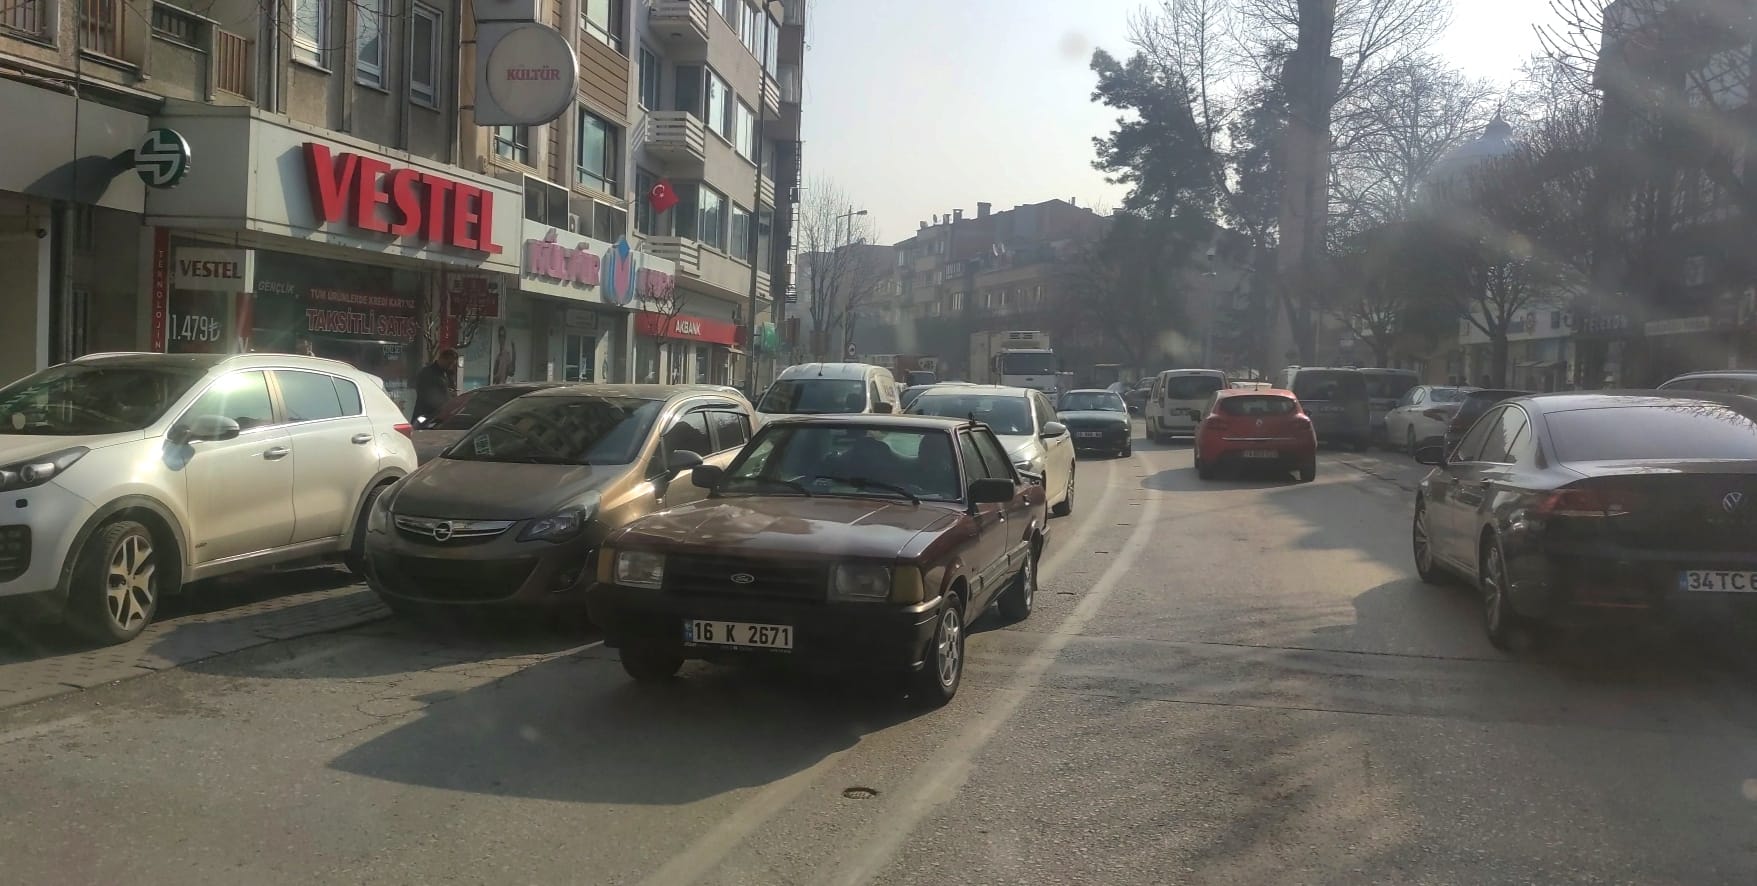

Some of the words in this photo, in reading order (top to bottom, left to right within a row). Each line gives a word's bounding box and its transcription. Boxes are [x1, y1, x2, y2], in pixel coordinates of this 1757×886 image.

[507, 65, 560, 80] KÜLTÜR
[302, 142, 503, 254] VESTEL
[179, 260, 242, 279] VESTEL
[305, 307, 375, 335] TAKSİTLİ
[675, 319, 701, 336] AKBANK
[695, 622, 713, 641] 16
[726, 624, 736, 642] K
[748, 625, 789, 646] 2671
